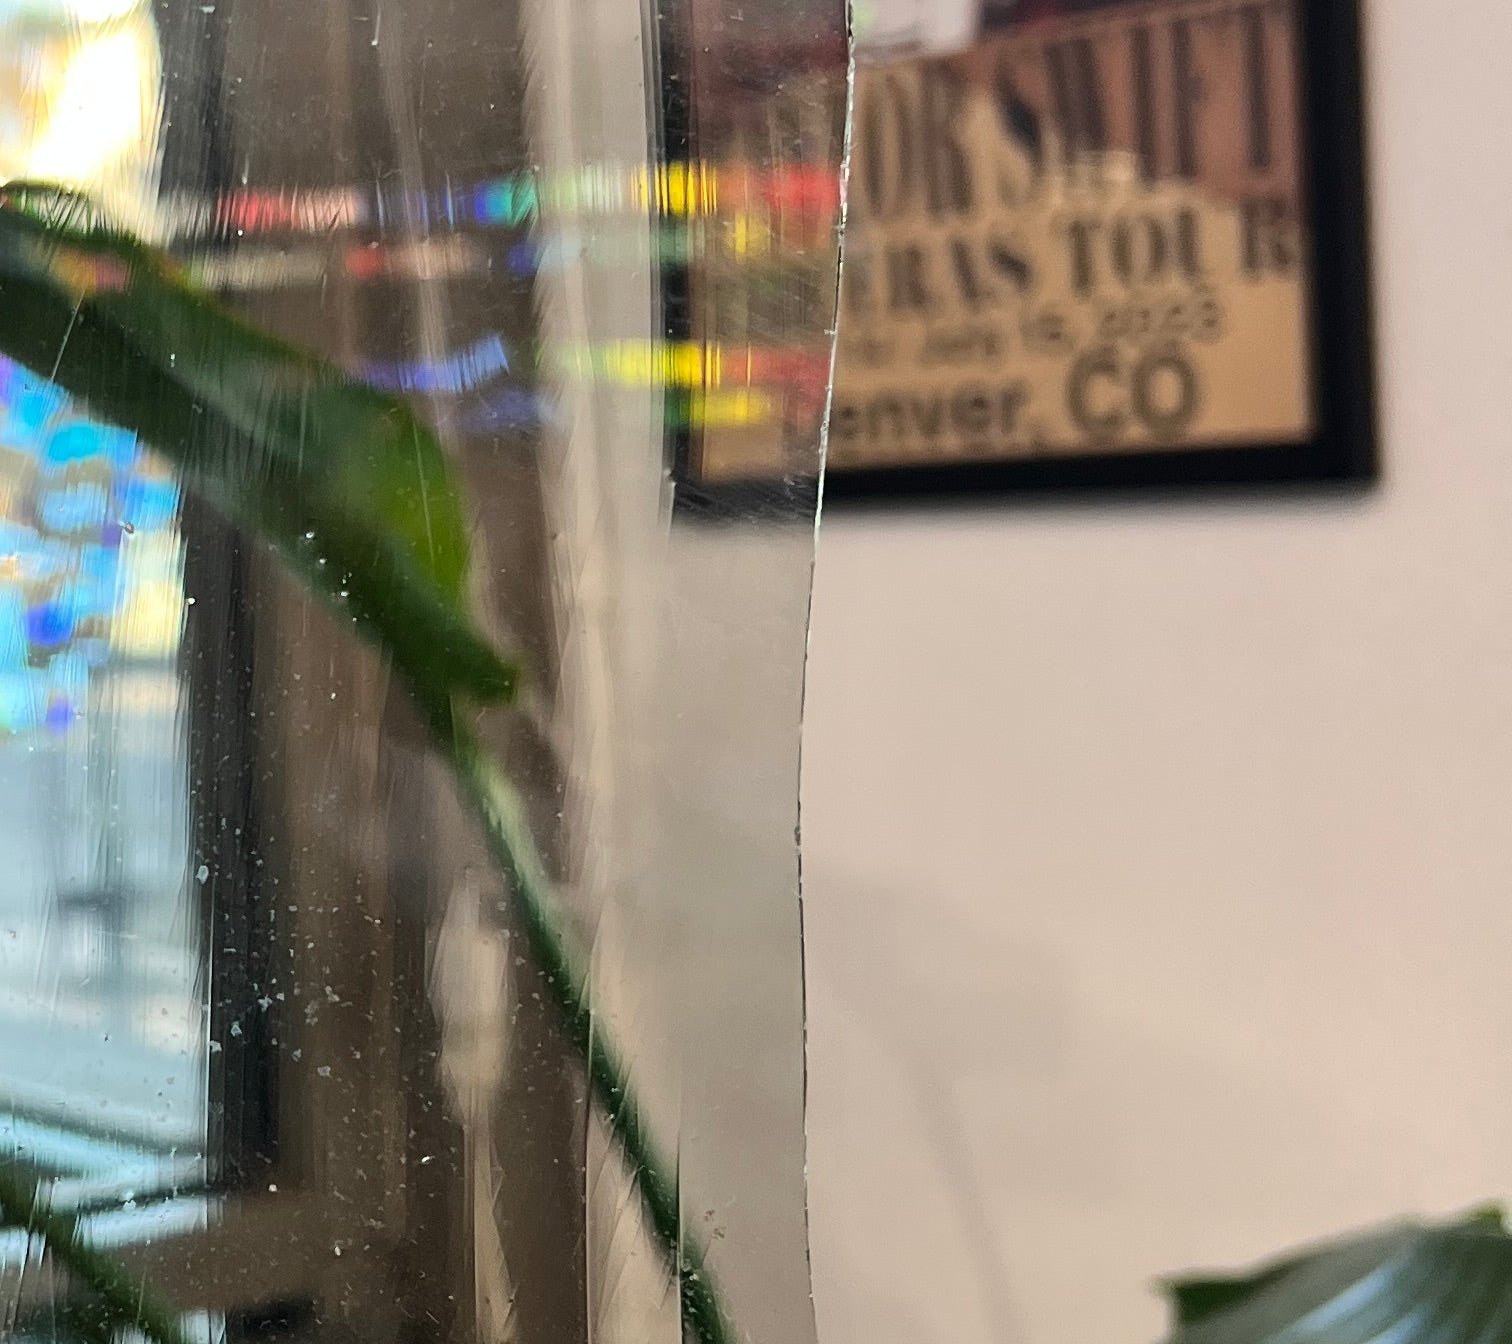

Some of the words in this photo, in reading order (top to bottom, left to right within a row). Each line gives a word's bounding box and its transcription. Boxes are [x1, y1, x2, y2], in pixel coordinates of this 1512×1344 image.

[986, 1, 1294, 206] SWIFT
[1048, 190, 1300, 302] TOUR
[826, 376, 1058, 454] enver,
[1064, 340, 1204, 442] CO
